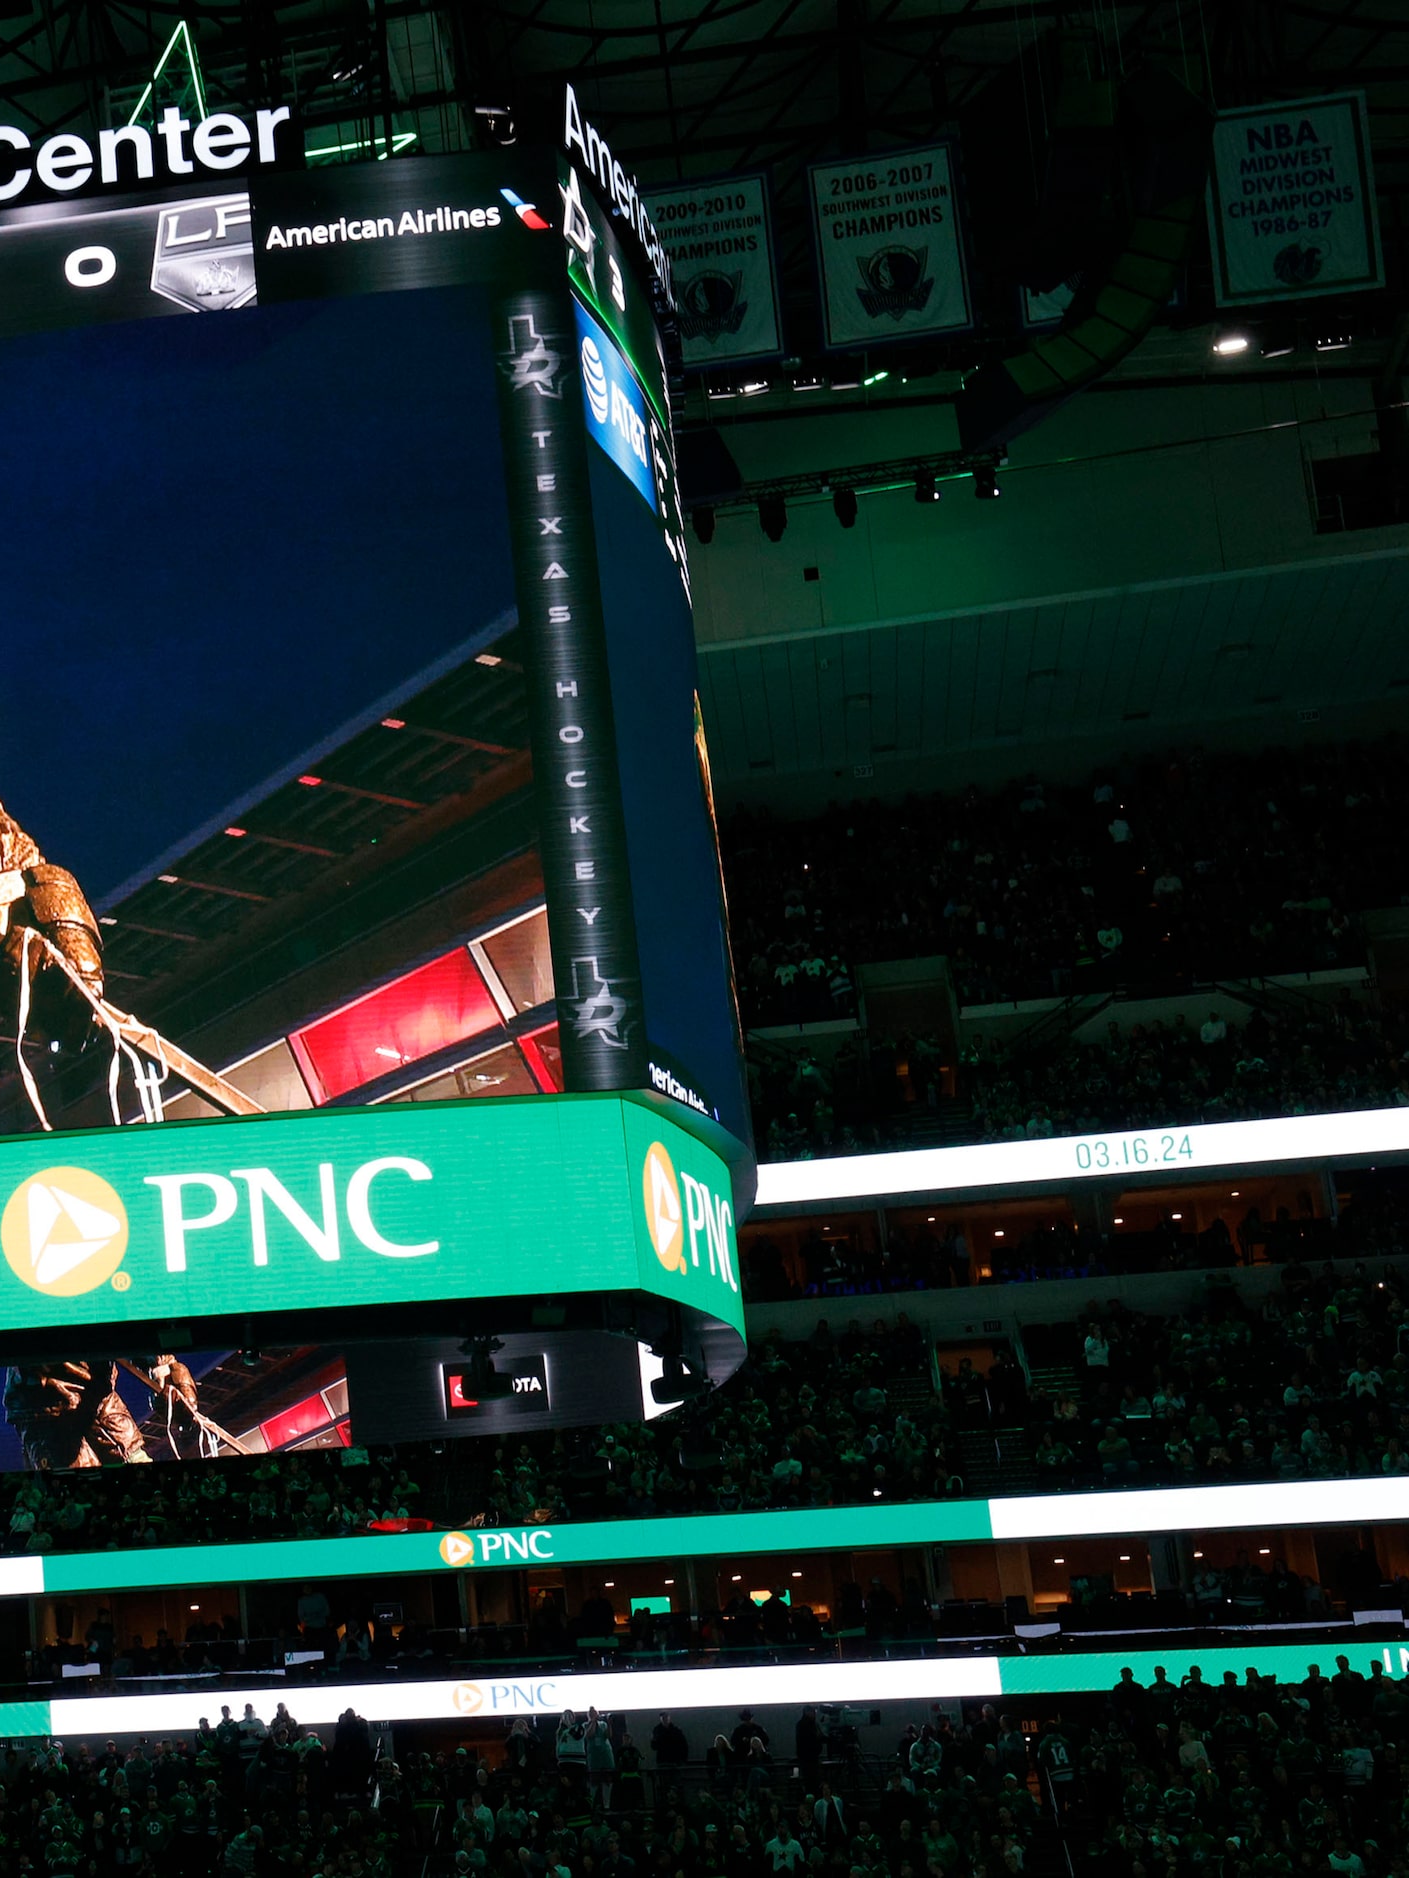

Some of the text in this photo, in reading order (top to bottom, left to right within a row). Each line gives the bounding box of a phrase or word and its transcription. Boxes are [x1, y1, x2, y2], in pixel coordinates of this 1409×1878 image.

[1246, 119, 1319, 153] NBA
[1239, 146, 1333, 175] MIDWEST
[830, 162, 934, 196] 2006-2007
[1242, 167, 1335, 196] DIVISION
[655, 193, 747, 223] 2009-2010
[822, 185, 948, 217] SOUTHWEST DIVISION
[1227, 185, 1354, 219] CHAMPIONS
[265, 206, 501, 250] American Airlines
[658, 214, 762, 241] UTHWEST DIVISION
[832, 206, 944, 240] CHAMPIONS
[1251, 210, 1333, 238] 1986-87
[667, 234, 758, 262] HAMPIONS
[610, 379, 649, 469] AT&T
[1075, 1134, 1194, 1171] 03.16.24
[143, 1156, 440, 1273] PNC
[679, 1170, 738, 1293] PNC
[511, 1376, 543, 1393] OTA
[478, 1530, 554, 1561] PNC
[491, 1682, 556, 1710] PNC
